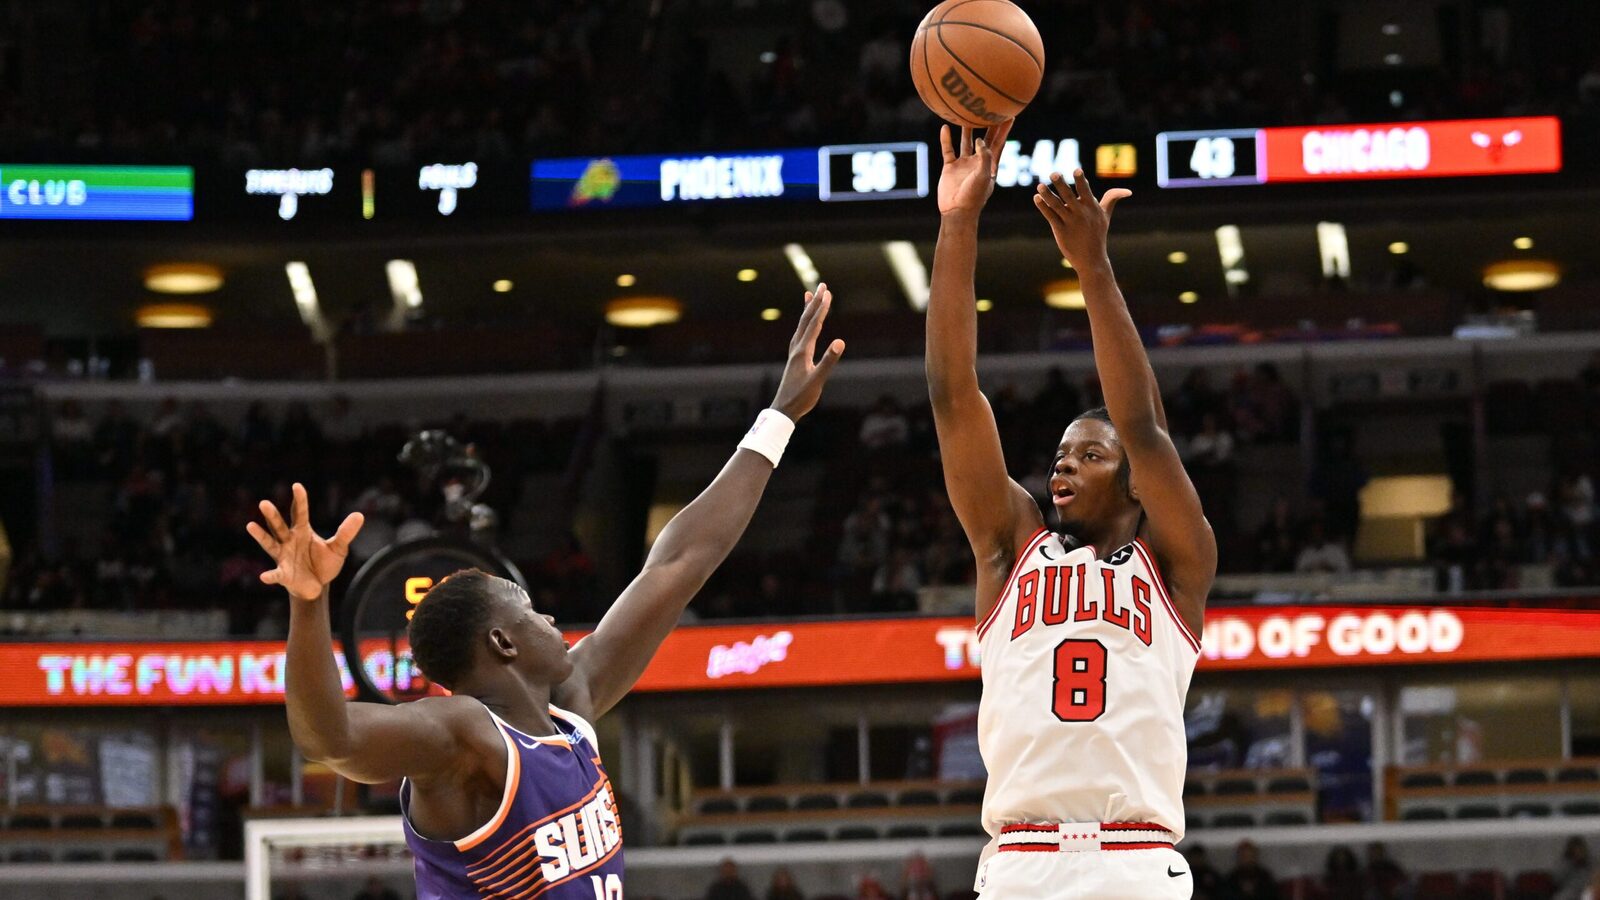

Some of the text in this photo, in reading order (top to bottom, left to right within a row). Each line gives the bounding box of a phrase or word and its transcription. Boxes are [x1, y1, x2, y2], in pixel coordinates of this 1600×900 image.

[1189, 137, 1235, 179] 43
[1302, 127, 1430, 174] CHICAGO
[8, 179, 87, 206] CLUB
[660, 156, 784, 201] PHOENIX
[1010, 563, 1153, 647] BULLS
[1258, 615, 1325, 658] OF
[1327, 609, 1464, 655] GOOD
[38, 655, 133, 695] THE
[136, 654, 233, 695] FUN
[1052, 639, 1107, 722] 8
[534, 785, 620, 882] SUNS
